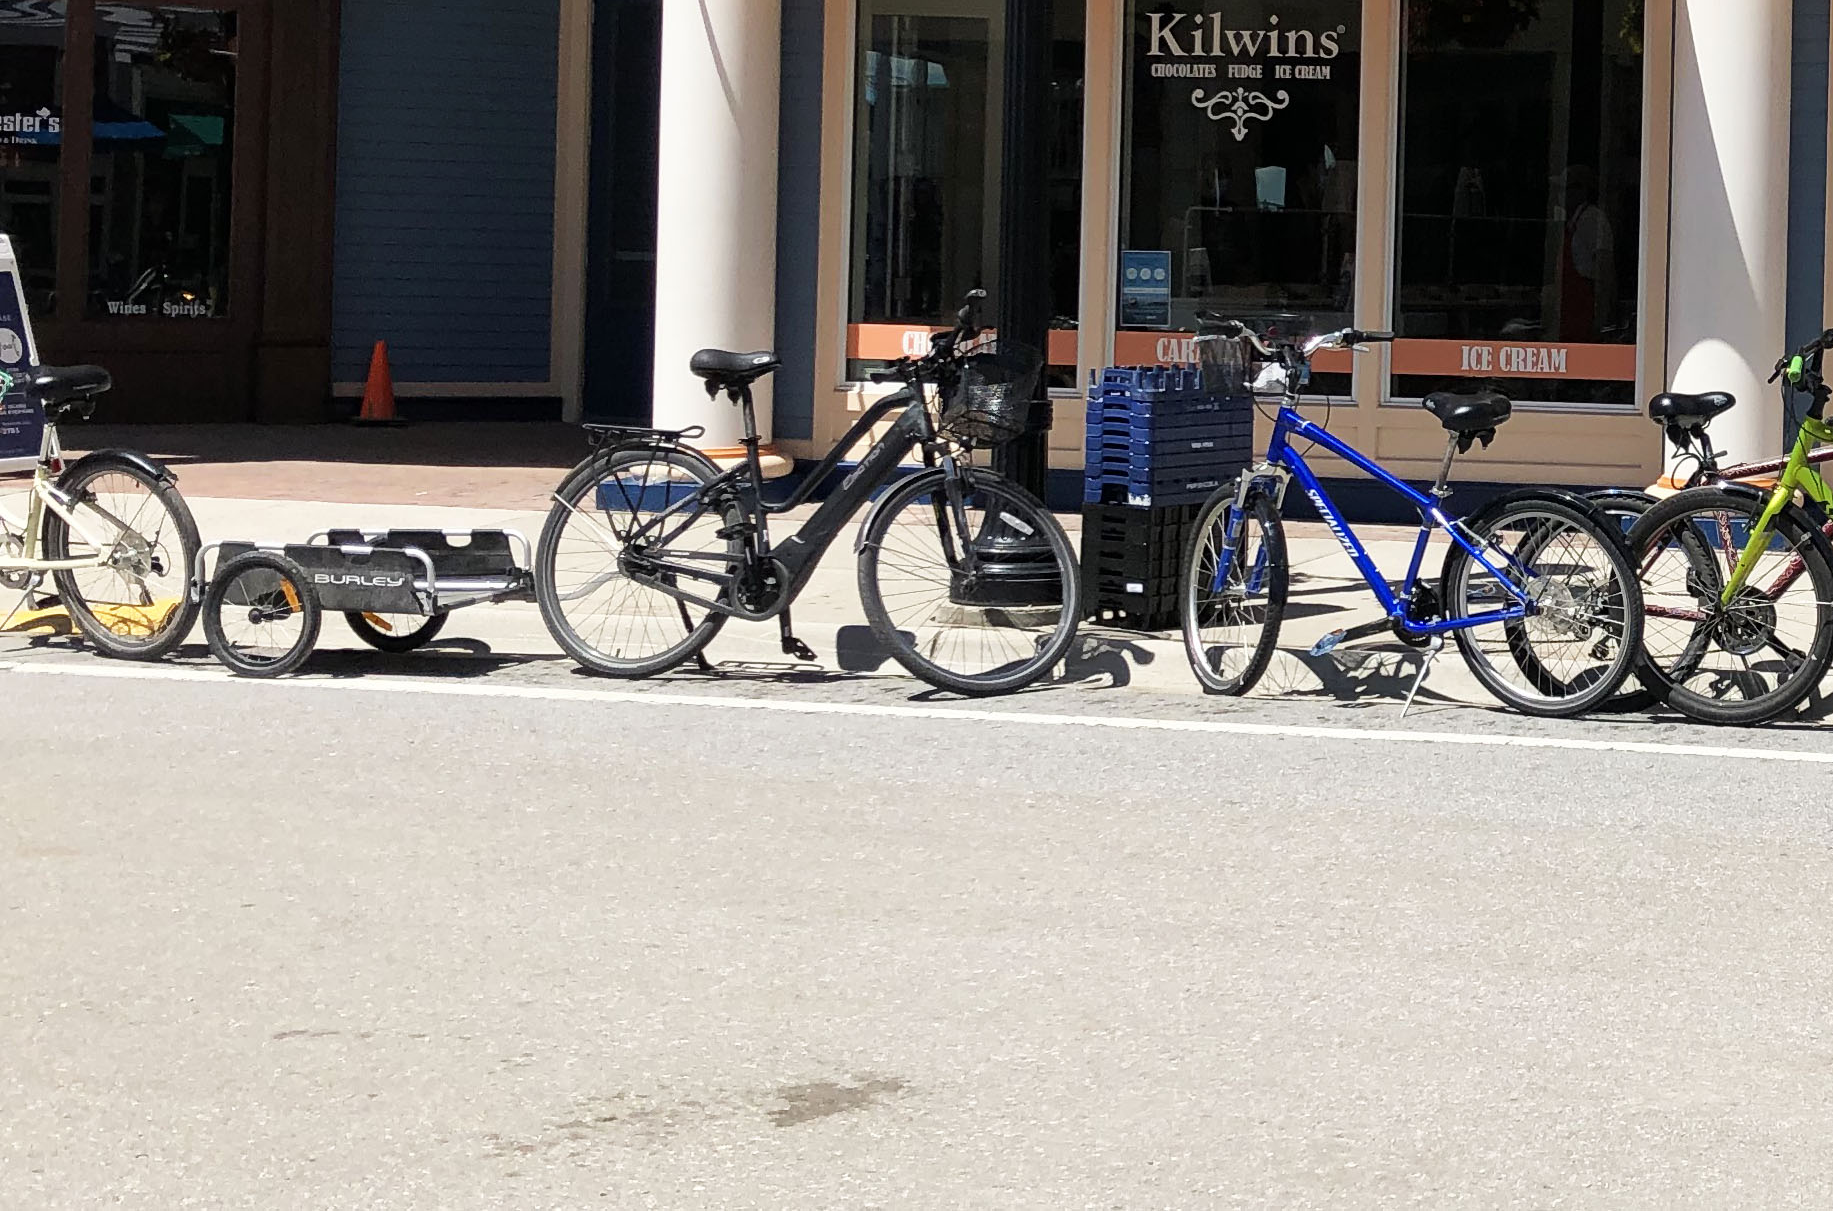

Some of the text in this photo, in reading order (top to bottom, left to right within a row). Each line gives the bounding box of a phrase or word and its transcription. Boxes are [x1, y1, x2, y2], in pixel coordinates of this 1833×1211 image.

[1151, 63, 1331, 80] CHOCOLATES FUDGE ICE CREAM
[0, 112, 60, 132] ster's
[1461, 346, 1568, 373] ICE CREAM
[314, 573, 405, 588] BURLEY
